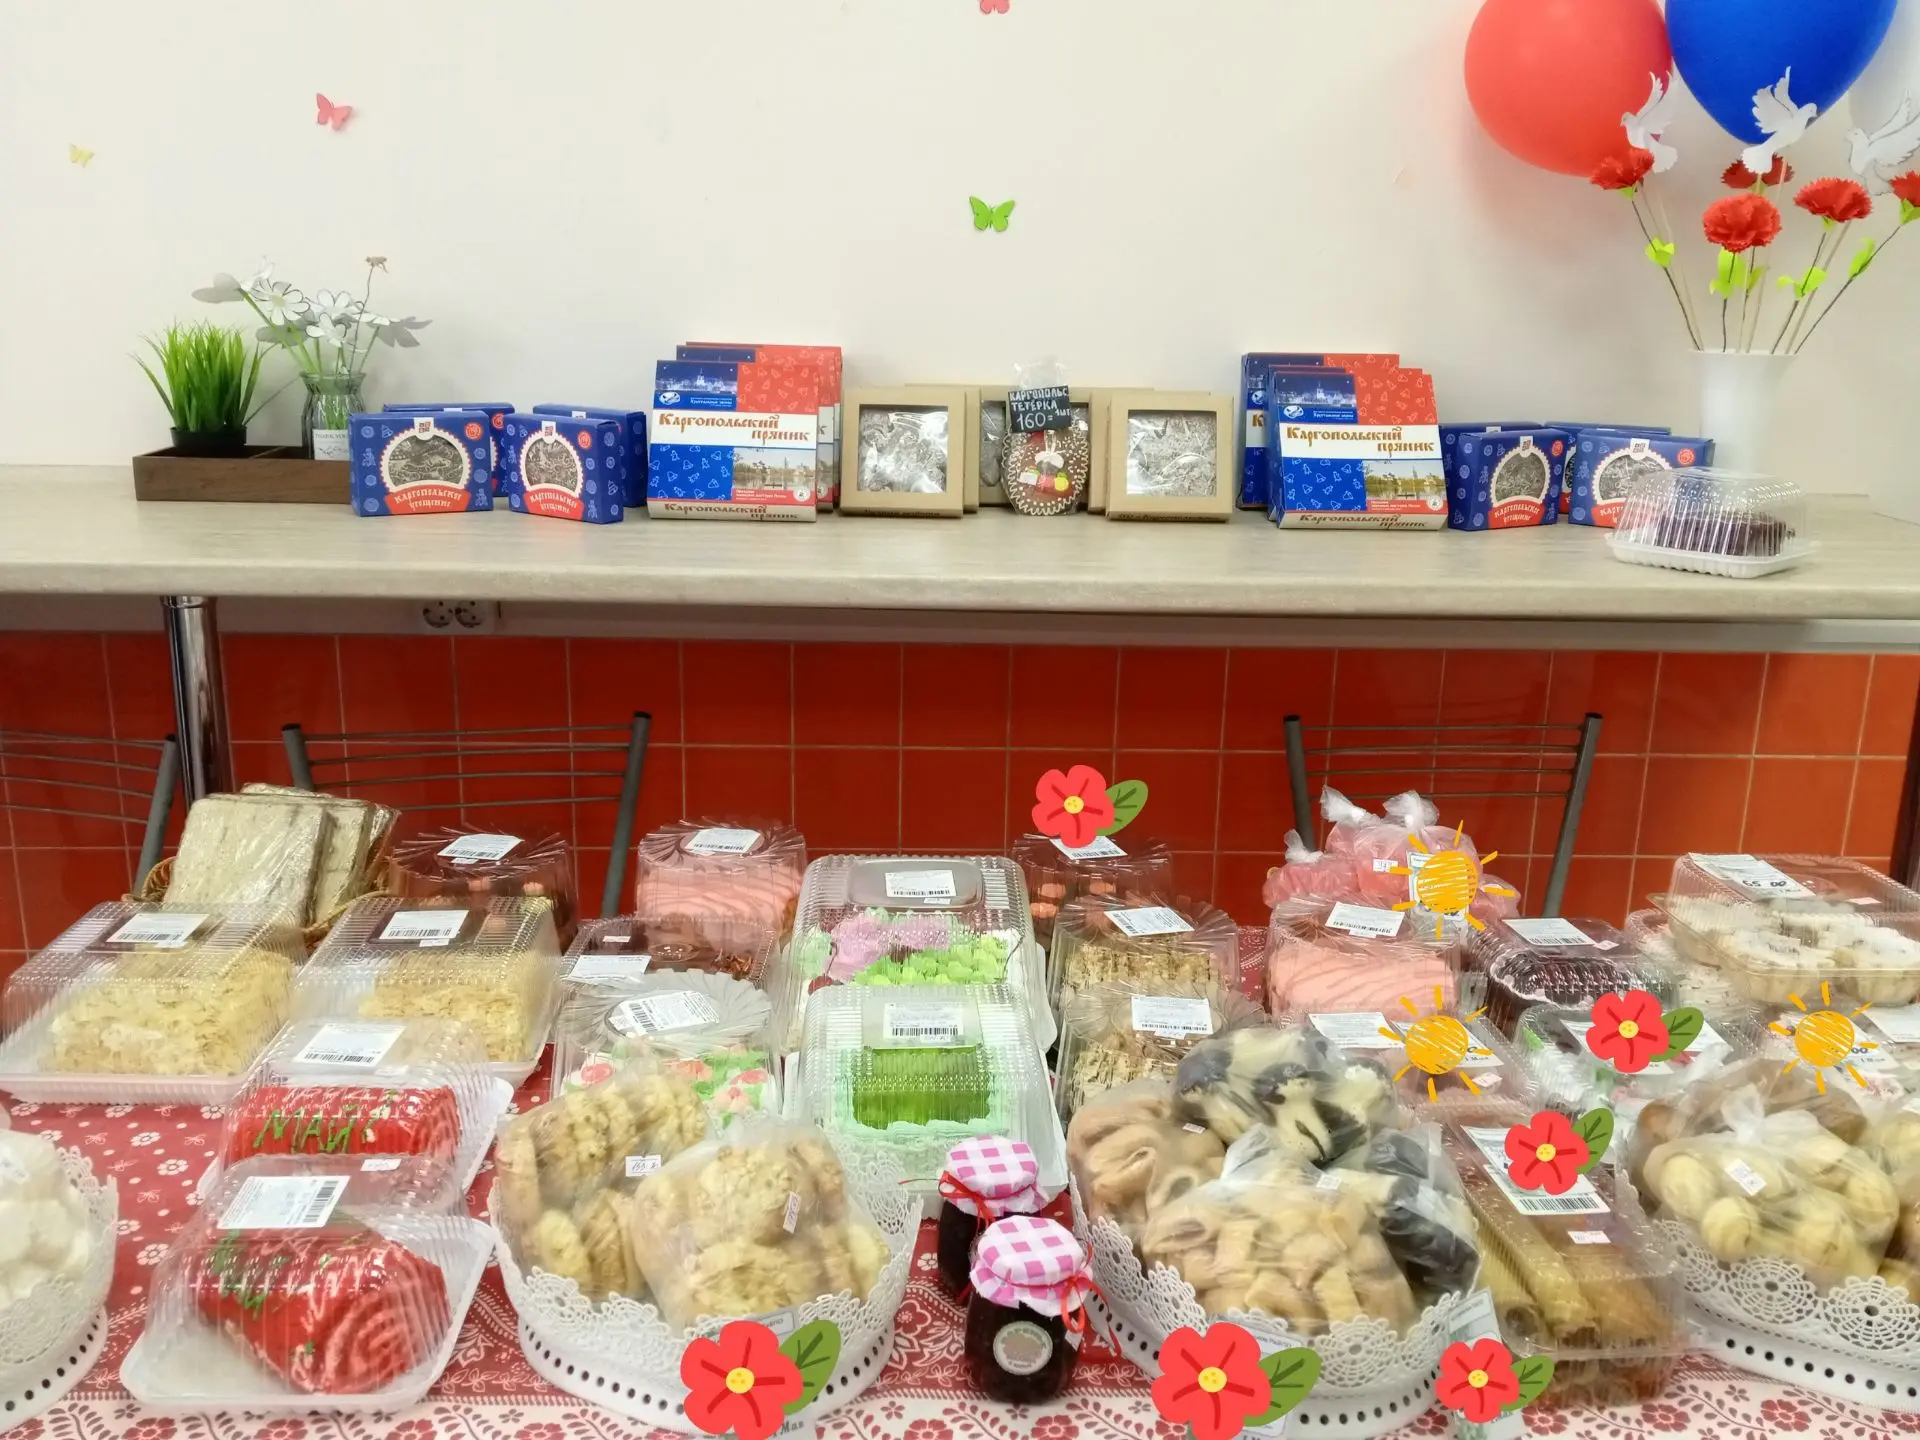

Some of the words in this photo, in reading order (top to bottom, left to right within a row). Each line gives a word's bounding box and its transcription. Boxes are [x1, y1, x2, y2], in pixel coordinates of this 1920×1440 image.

[659, 412, 780, 433] Каргопольский
[751, 429, 810, 445] пряник
[1286, 426, 1402, 447] Каргопольский
[1377, 441, 1435, 457] пряник
[664, 501, 768, 515] Каргопольский
[1299, 512, 1401, 525] Каргопольский
